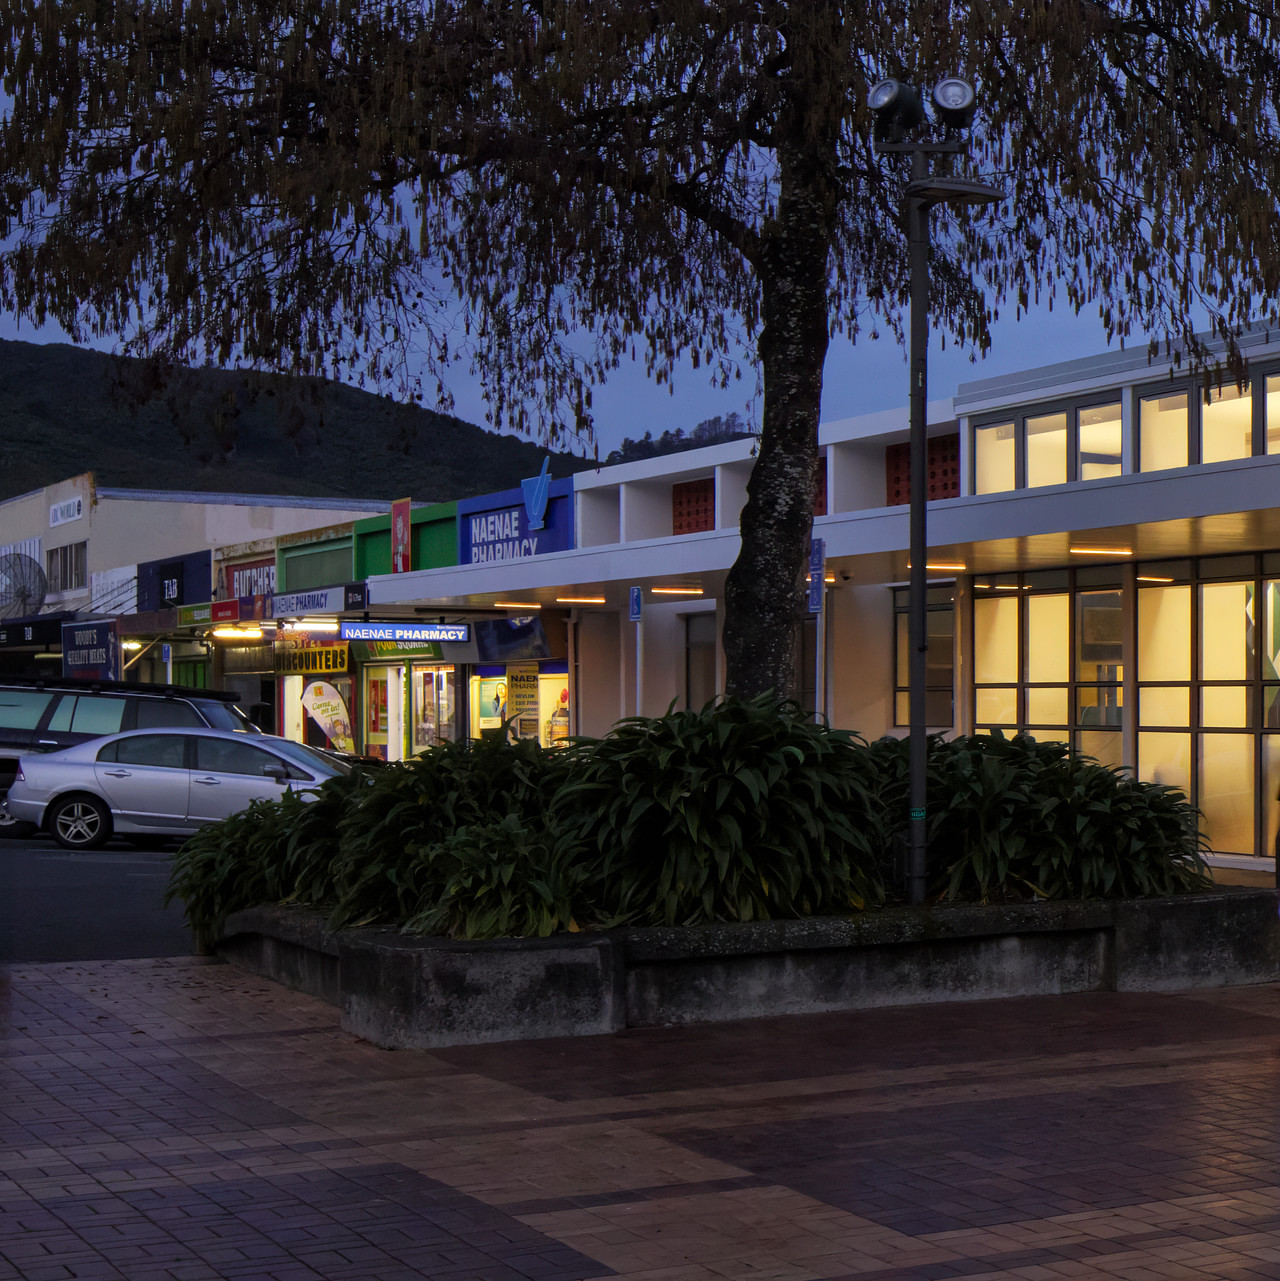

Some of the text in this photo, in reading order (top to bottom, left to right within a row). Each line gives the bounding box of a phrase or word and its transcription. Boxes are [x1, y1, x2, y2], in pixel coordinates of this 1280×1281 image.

[471, 511, 519, 544] NAENAE
[471, 537, 538, 563] PHARMACY
[163, 578, 178, 600] TAB
[295, 592, 329, 610] PHARMACY
[345, 629, 465, 640] NAENAE PHARMACY
[68, 648, 106, 665] QUALITY MEATS
